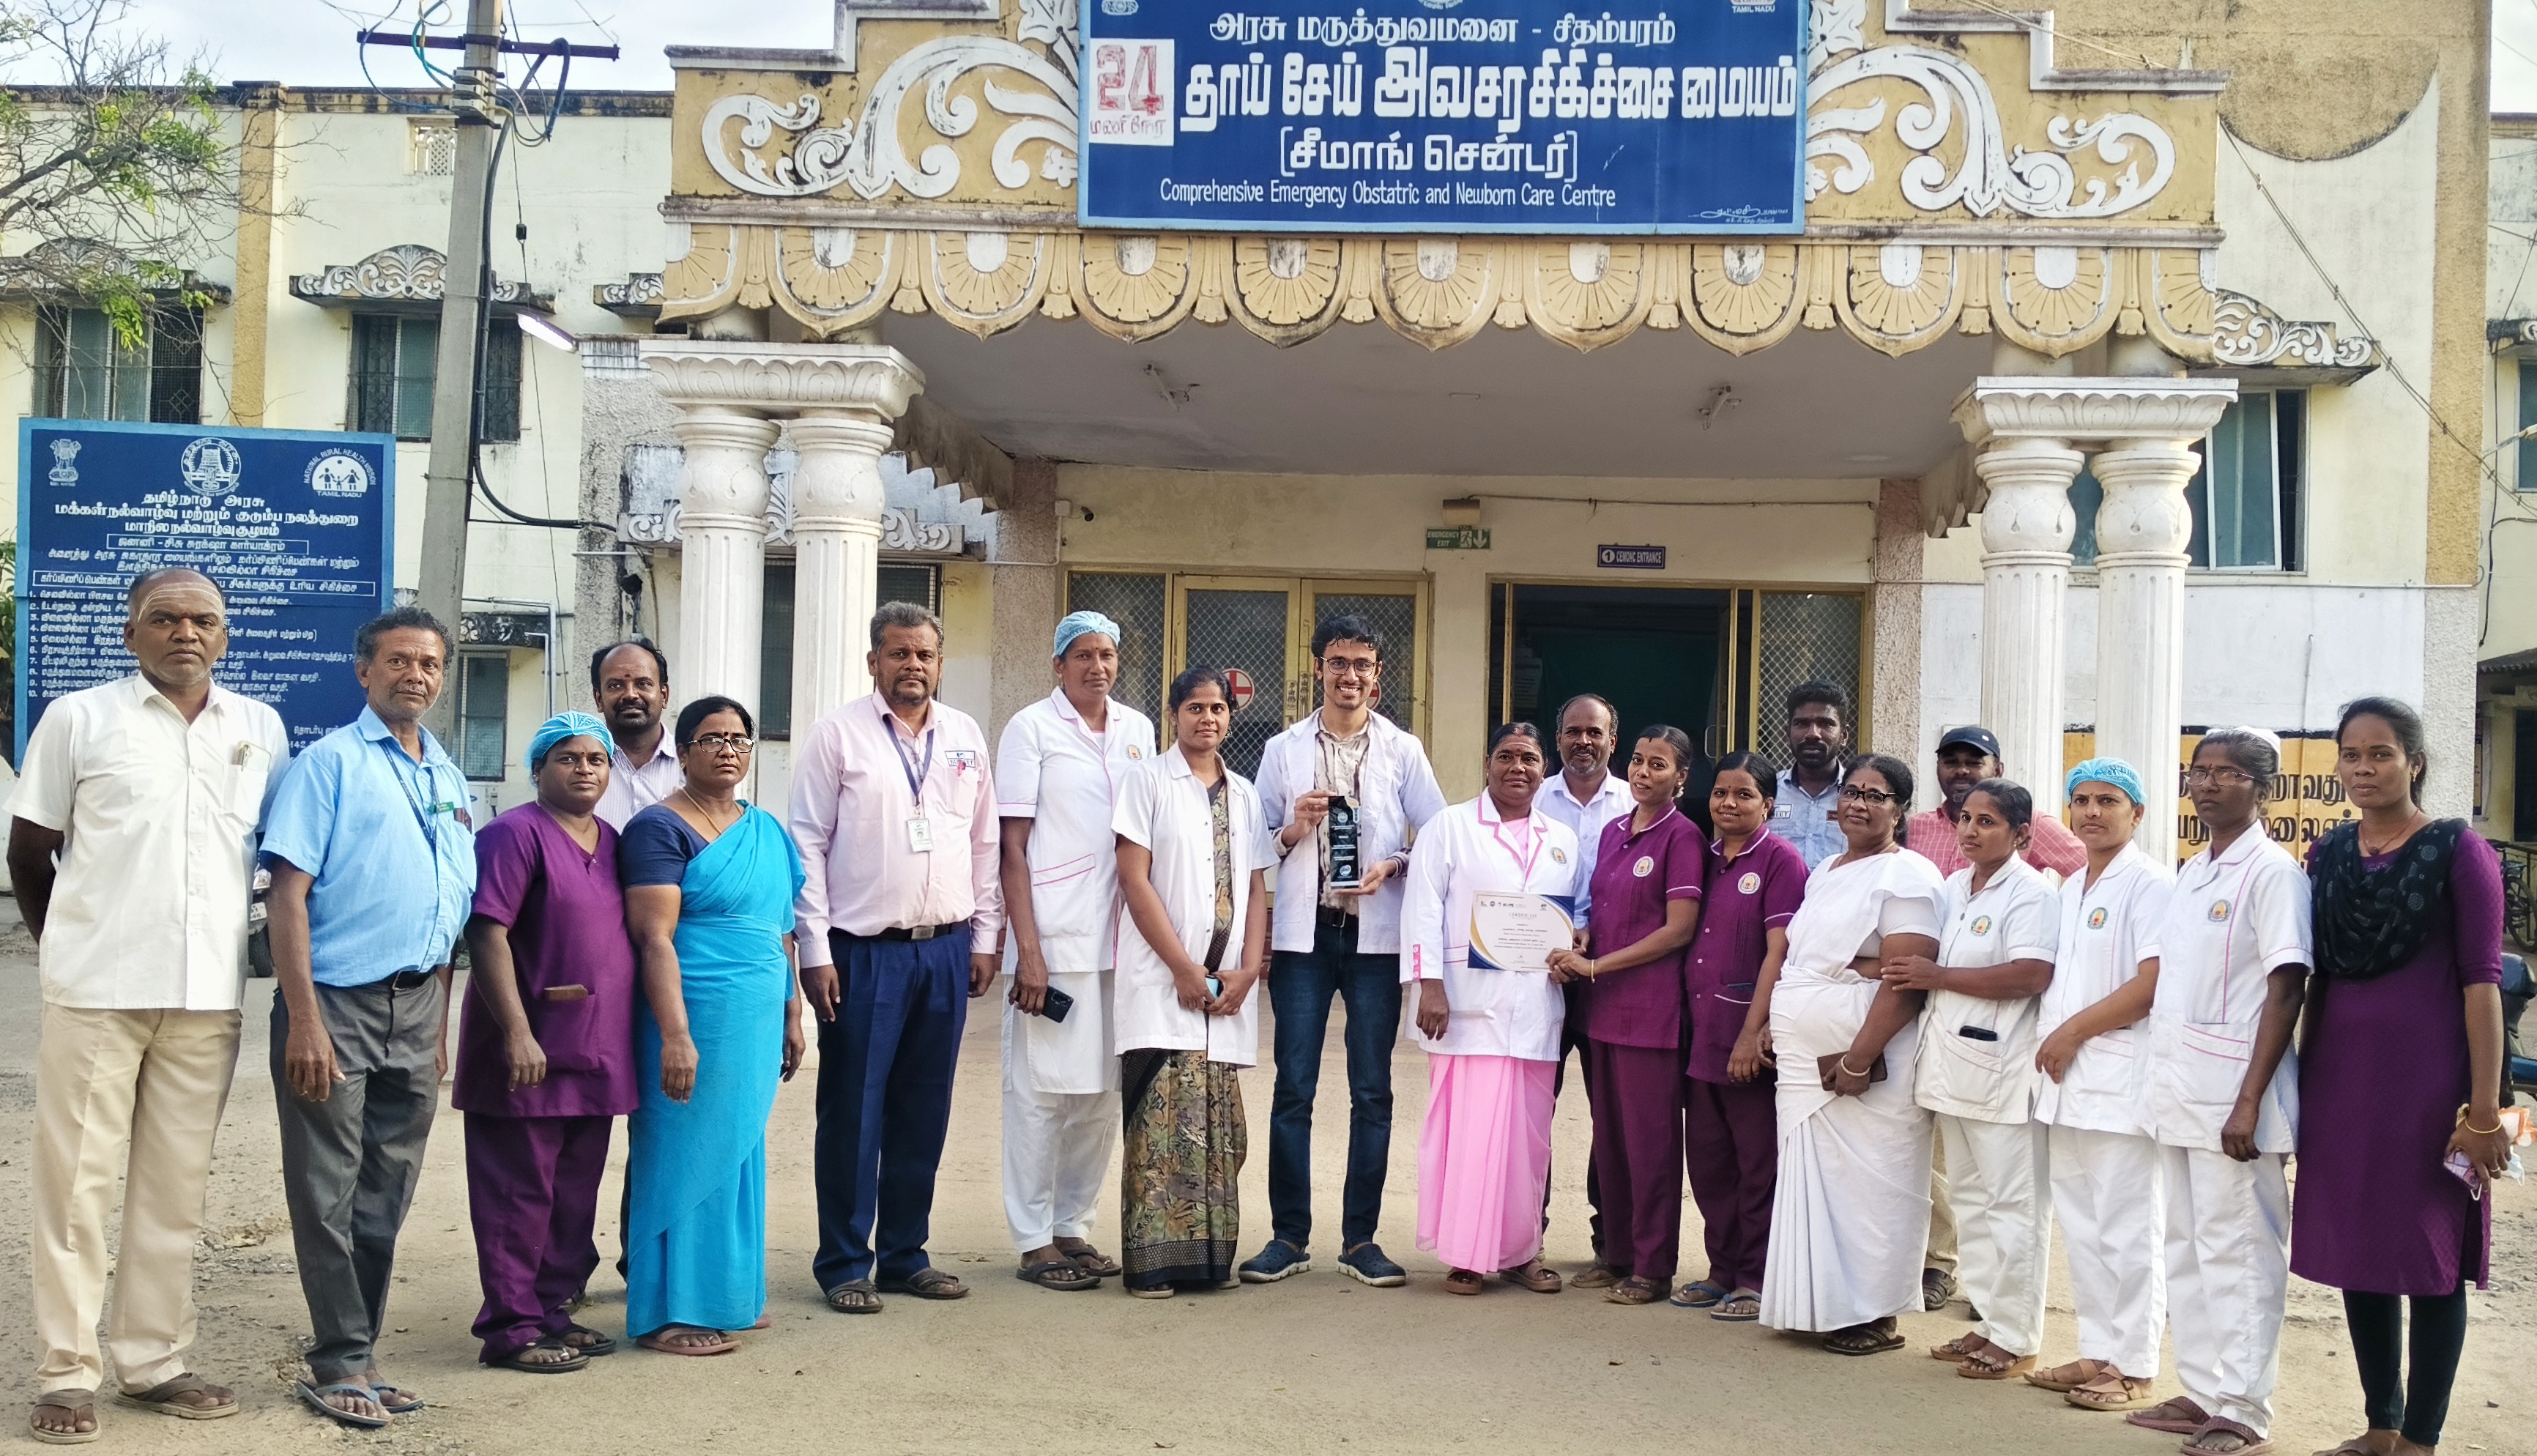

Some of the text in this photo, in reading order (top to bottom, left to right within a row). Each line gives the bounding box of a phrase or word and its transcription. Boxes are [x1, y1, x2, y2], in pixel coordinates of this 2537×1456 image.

[1731, 4, 1775, 13] TAMIL NADU
[1210, 12, 1287, 45] அரசு
[1297, 8, 1519, 46] மருத்துவமனை
[1553, 12, 1676, 48] சிதம்பரம்
[1096, 45, 1164, 116] 24
[1180, 52, 1271, 132] தாய்
[1282, 51, 1362, 116] சேய்
[1682, 55, 1797, 119] மையம்
[1160, 178, 1616, 208] Comprehensive Emergency Obstatric and Newborn Care Centre
[303, 456, 321, 484] NATIONAL
[320, 447, 342, 458] RURAL
[343, 448, 366, 466] HEALTH
[182, 505, 231, 523] மற்றும்
[224, 494, 265, 508] அரசு
[1637, 551, 1662, 563] ENTRANCE
